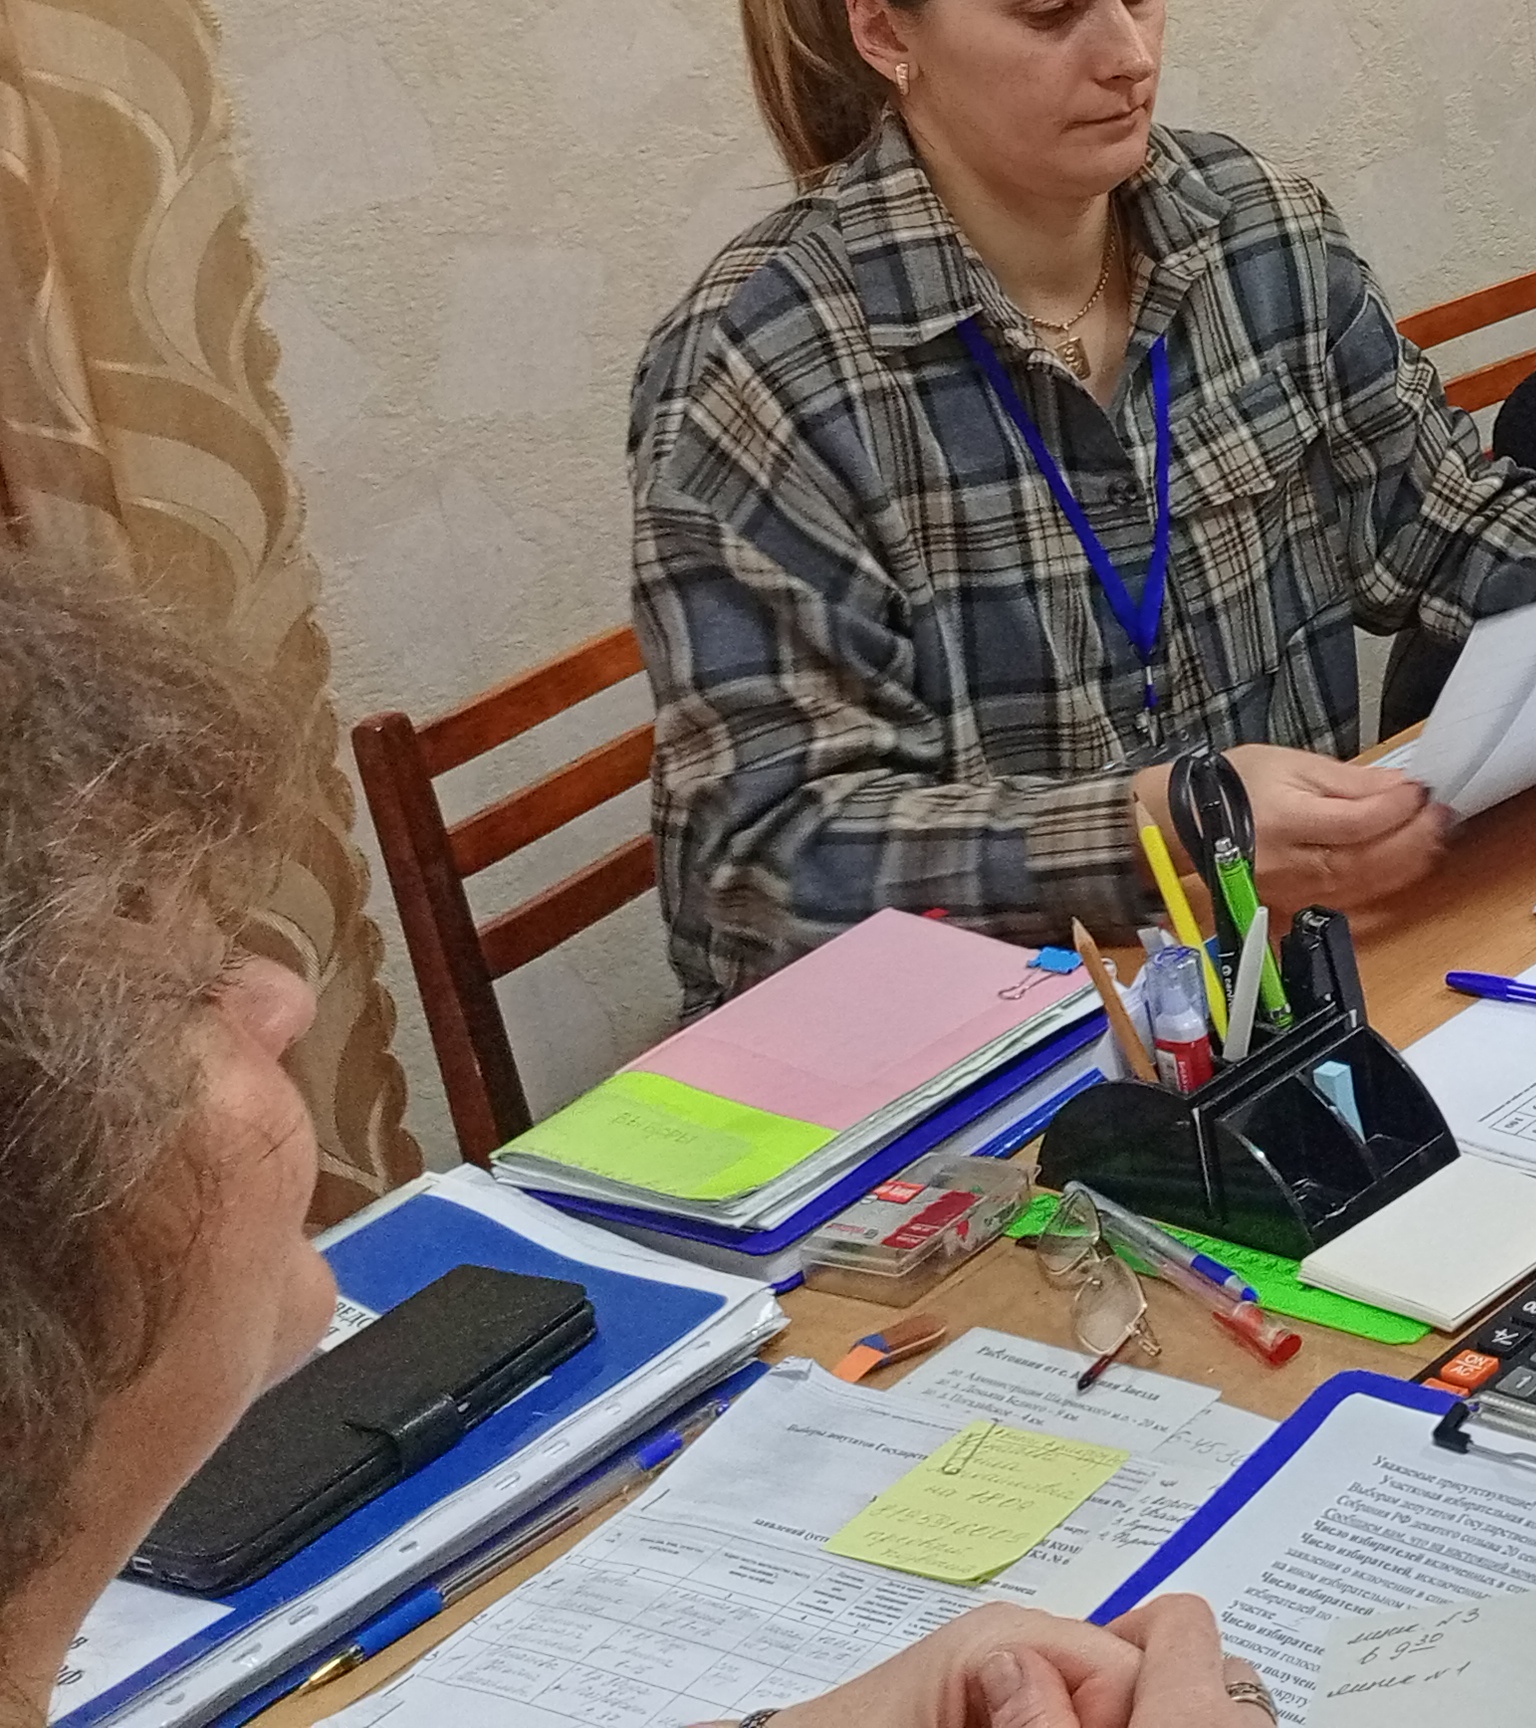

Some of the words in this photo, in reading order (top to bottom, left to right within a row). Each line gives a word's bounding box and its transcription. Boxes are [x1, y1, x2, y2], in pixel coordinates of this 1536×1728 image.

[1451, 1366, 1475, 1377] AC
[1464, 1354, 1484, 1366] ON
[1515, 1375, 1532, 1388] 1
[1347, 1481, 1400, 1505] Выборам
[1399, 1500, 1457, 1521] депутатов
[1379, 1474, 1442, 1501] Участковая
[1442, 1496, 1523, 1524] избирательная
[1336, 1494, 1390, 1518] Собрания
[1390, 1512, 1412, 1523] РФ
[1409, 1520, 1461, 1539] девятого
[1459, 1534, 1503, 1552] созыва
[1501, 1545, 1519, 1557] 20
[1284, 1548, 1342, 1571] заявления
[1351, 1570, 1417, 1596] включении
[1300, 1532, 1337, 1552] Число
[1336, 1550, 1414, 1578] избирателей,
[1314, 1520, 1350, 1538] Число
[1348, 1536, 1425, 1563] избирателей
[1424, 1557, 1496, 1586] включенных
[1409, 1536, 1429, 1547] что
[1445, 1545, 1510, 1572] настоящий
[1244, 1586, 1316, 1618] избирателей
[1314, 1612, 1333, 1621] по
[1261, 1571, 1298, 1591] Число
[1297, 1587, 1375, 1616] избирателей
[1271, 1560, 1288, 1570] на
[1287, 1565, 1319, 1580] ином
[1318, 1576, 1405, 1609] избирательном
[1221, 1611, 1257, 1631] Число
[1228, 1600, 1277, 1620] участке
